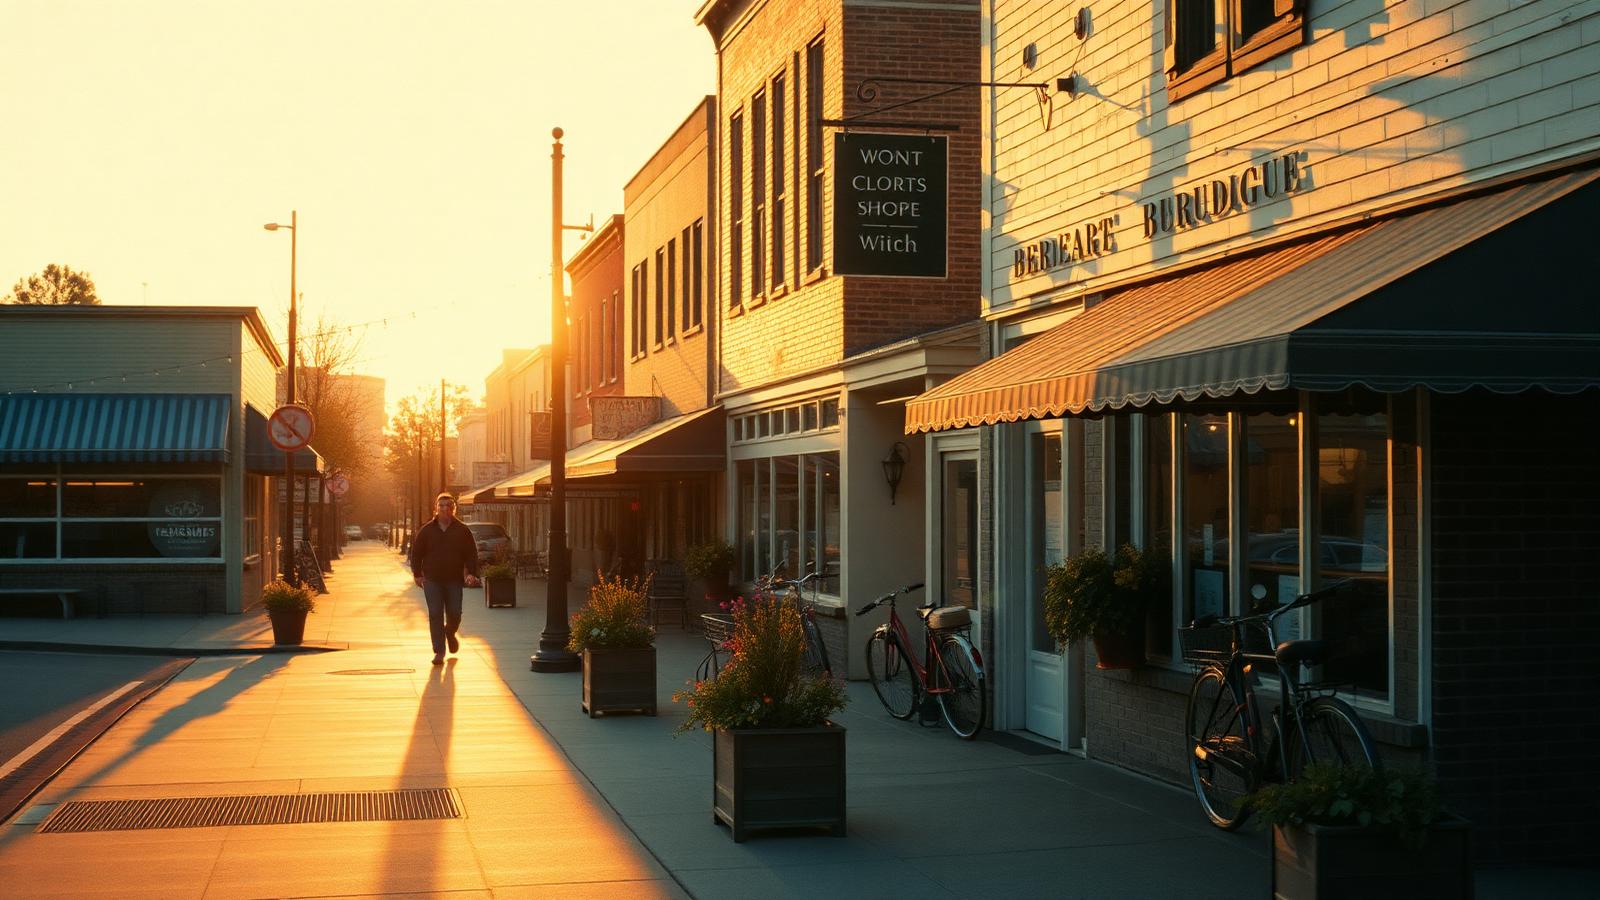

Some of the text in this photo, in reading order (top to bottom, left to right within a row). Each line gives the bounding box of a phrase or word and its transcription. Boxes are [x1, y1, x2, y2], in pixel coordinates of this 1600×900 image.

[859, 148, 923, 166] WONT
[852, 175, 927, 193] CLORTS
[857, 200, 920, 217] SHOPE
